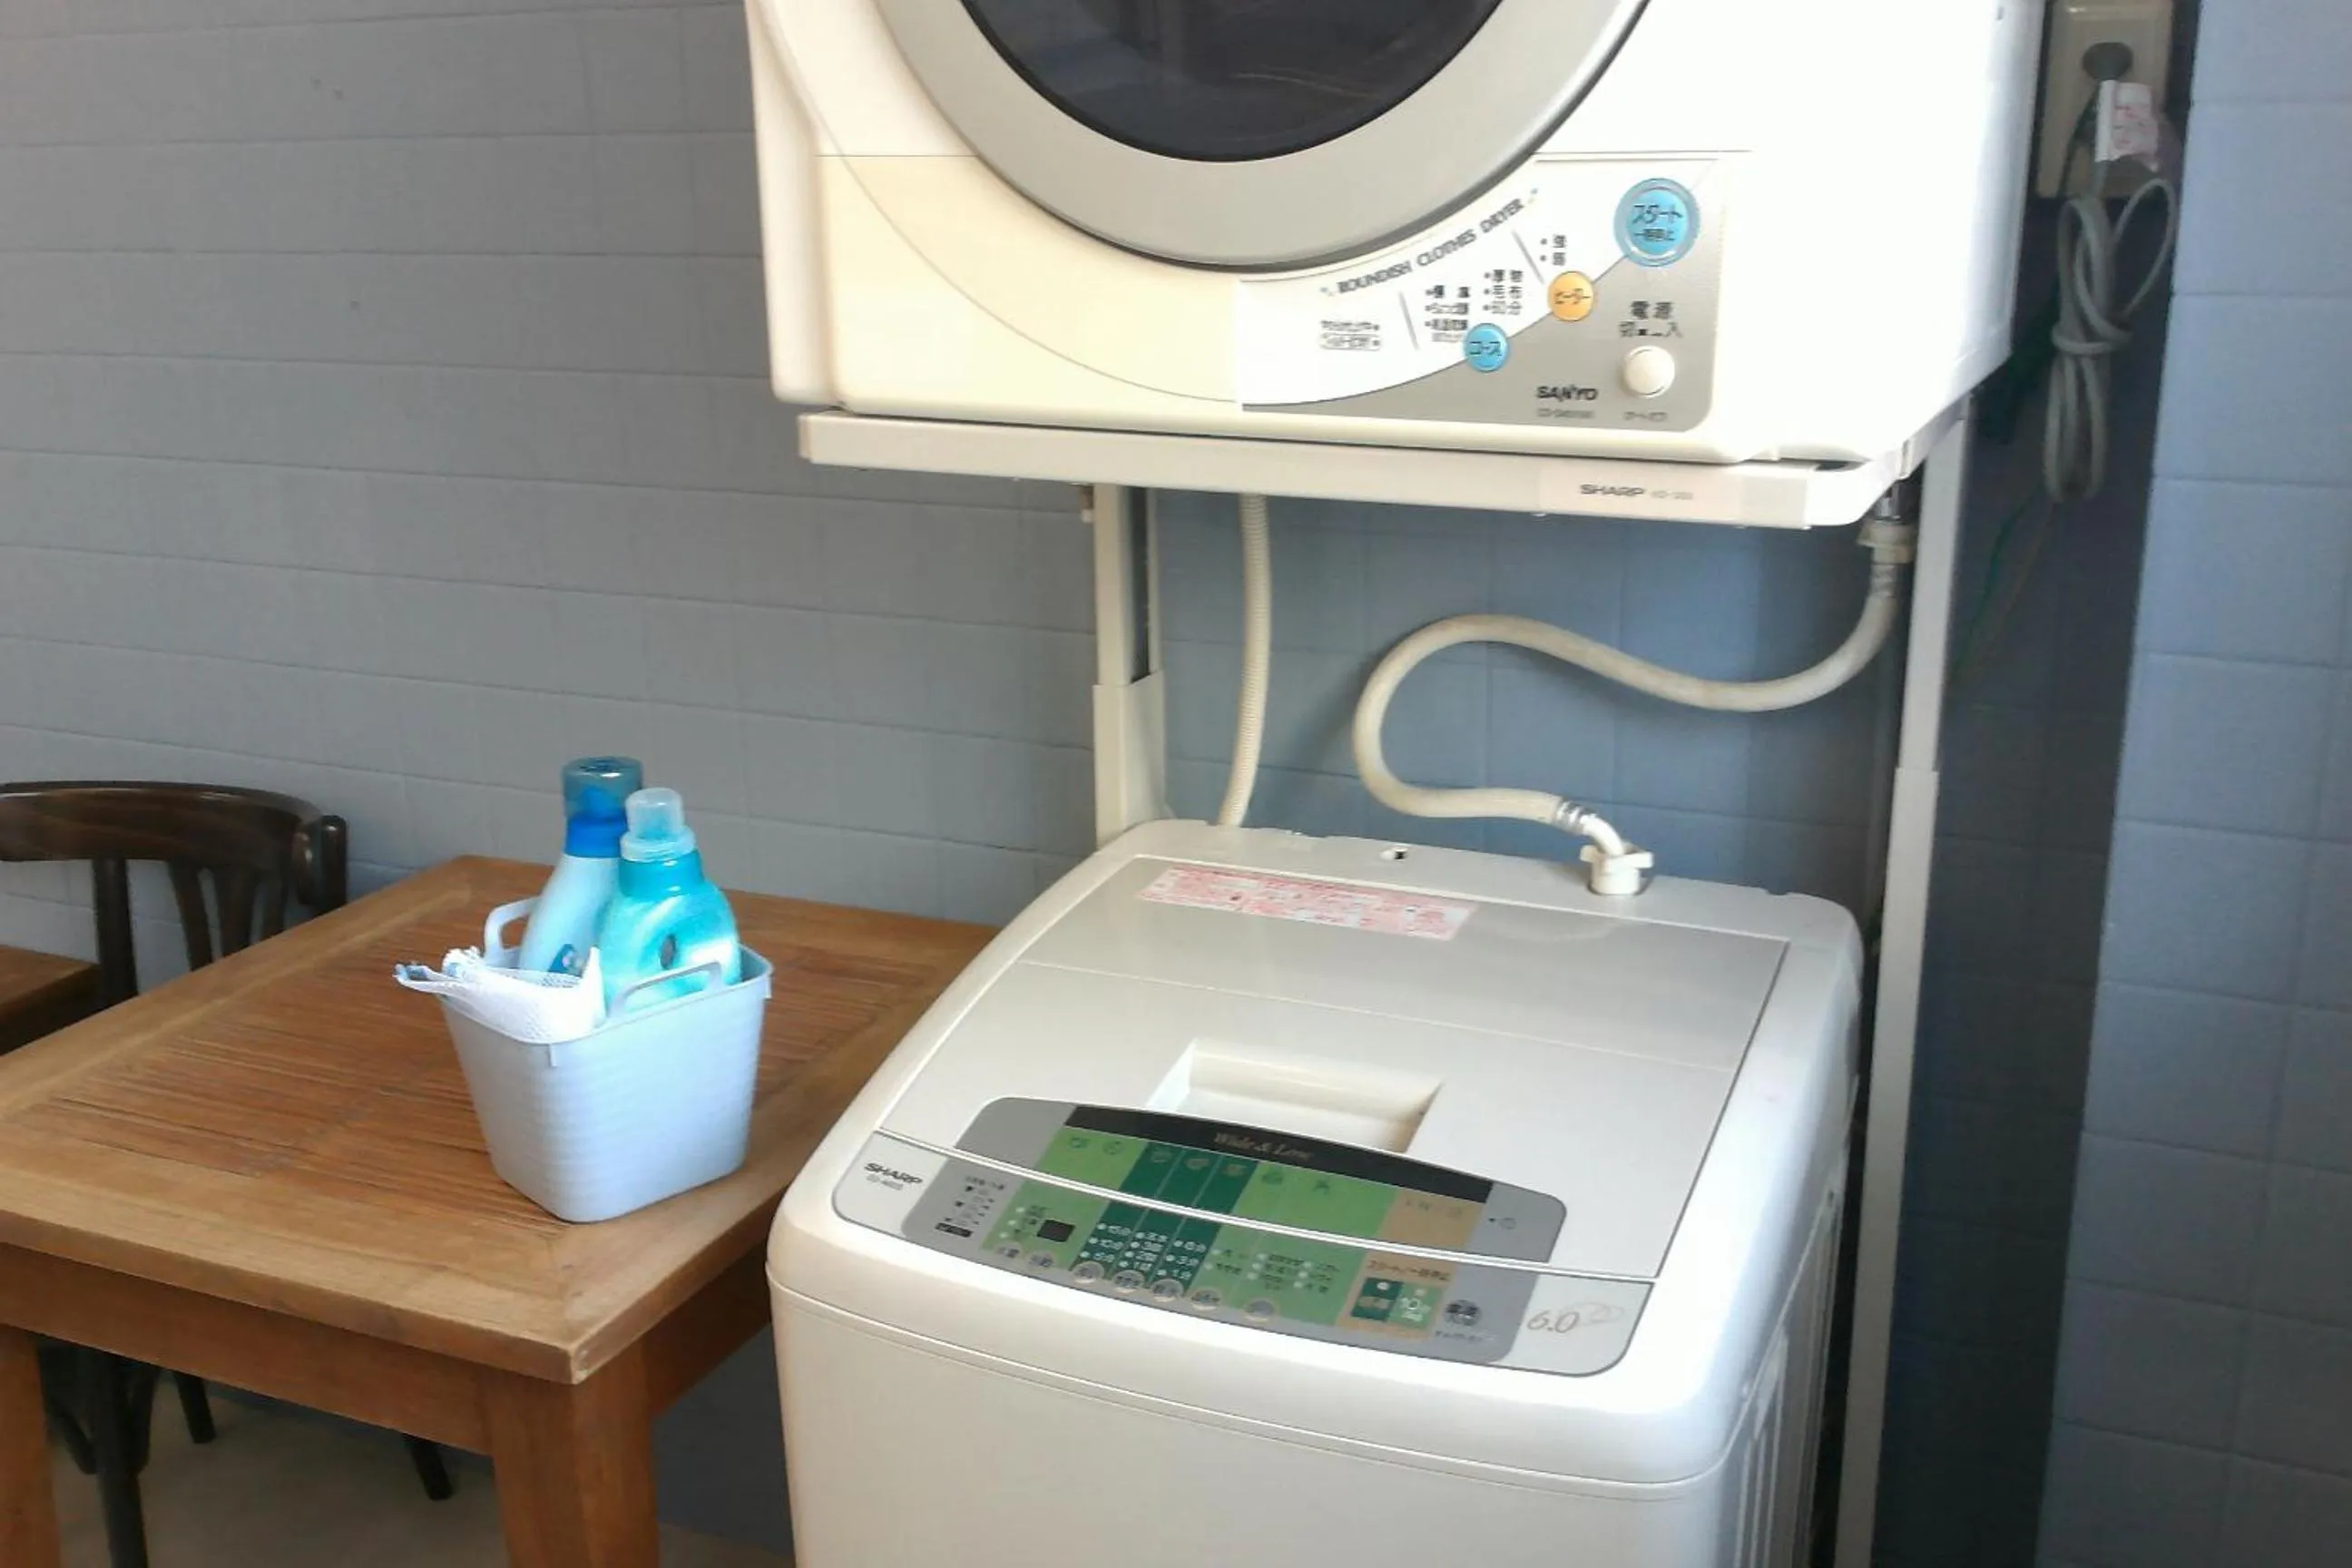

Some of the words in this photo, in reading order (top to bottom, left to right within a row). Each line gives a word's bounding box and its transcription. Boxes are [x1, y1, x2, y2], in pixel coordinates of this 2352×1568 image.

[1632, 203, 1684, 225] スタート
[1337, 261, 1412, 293] ROUNDISH
[1416, 230, 1477, 267] CLOTHES
[1480, 199, 1524, 233] DRYER
[1469, 341, 1503, 357] コース
[1536, 385, 1599, 402] SANYO
[1580, 484, 1645, 496] SHARP
[864, 1162, 924, 1184] SHARP
[1526, 1309, 1581, 1334] 6.0
